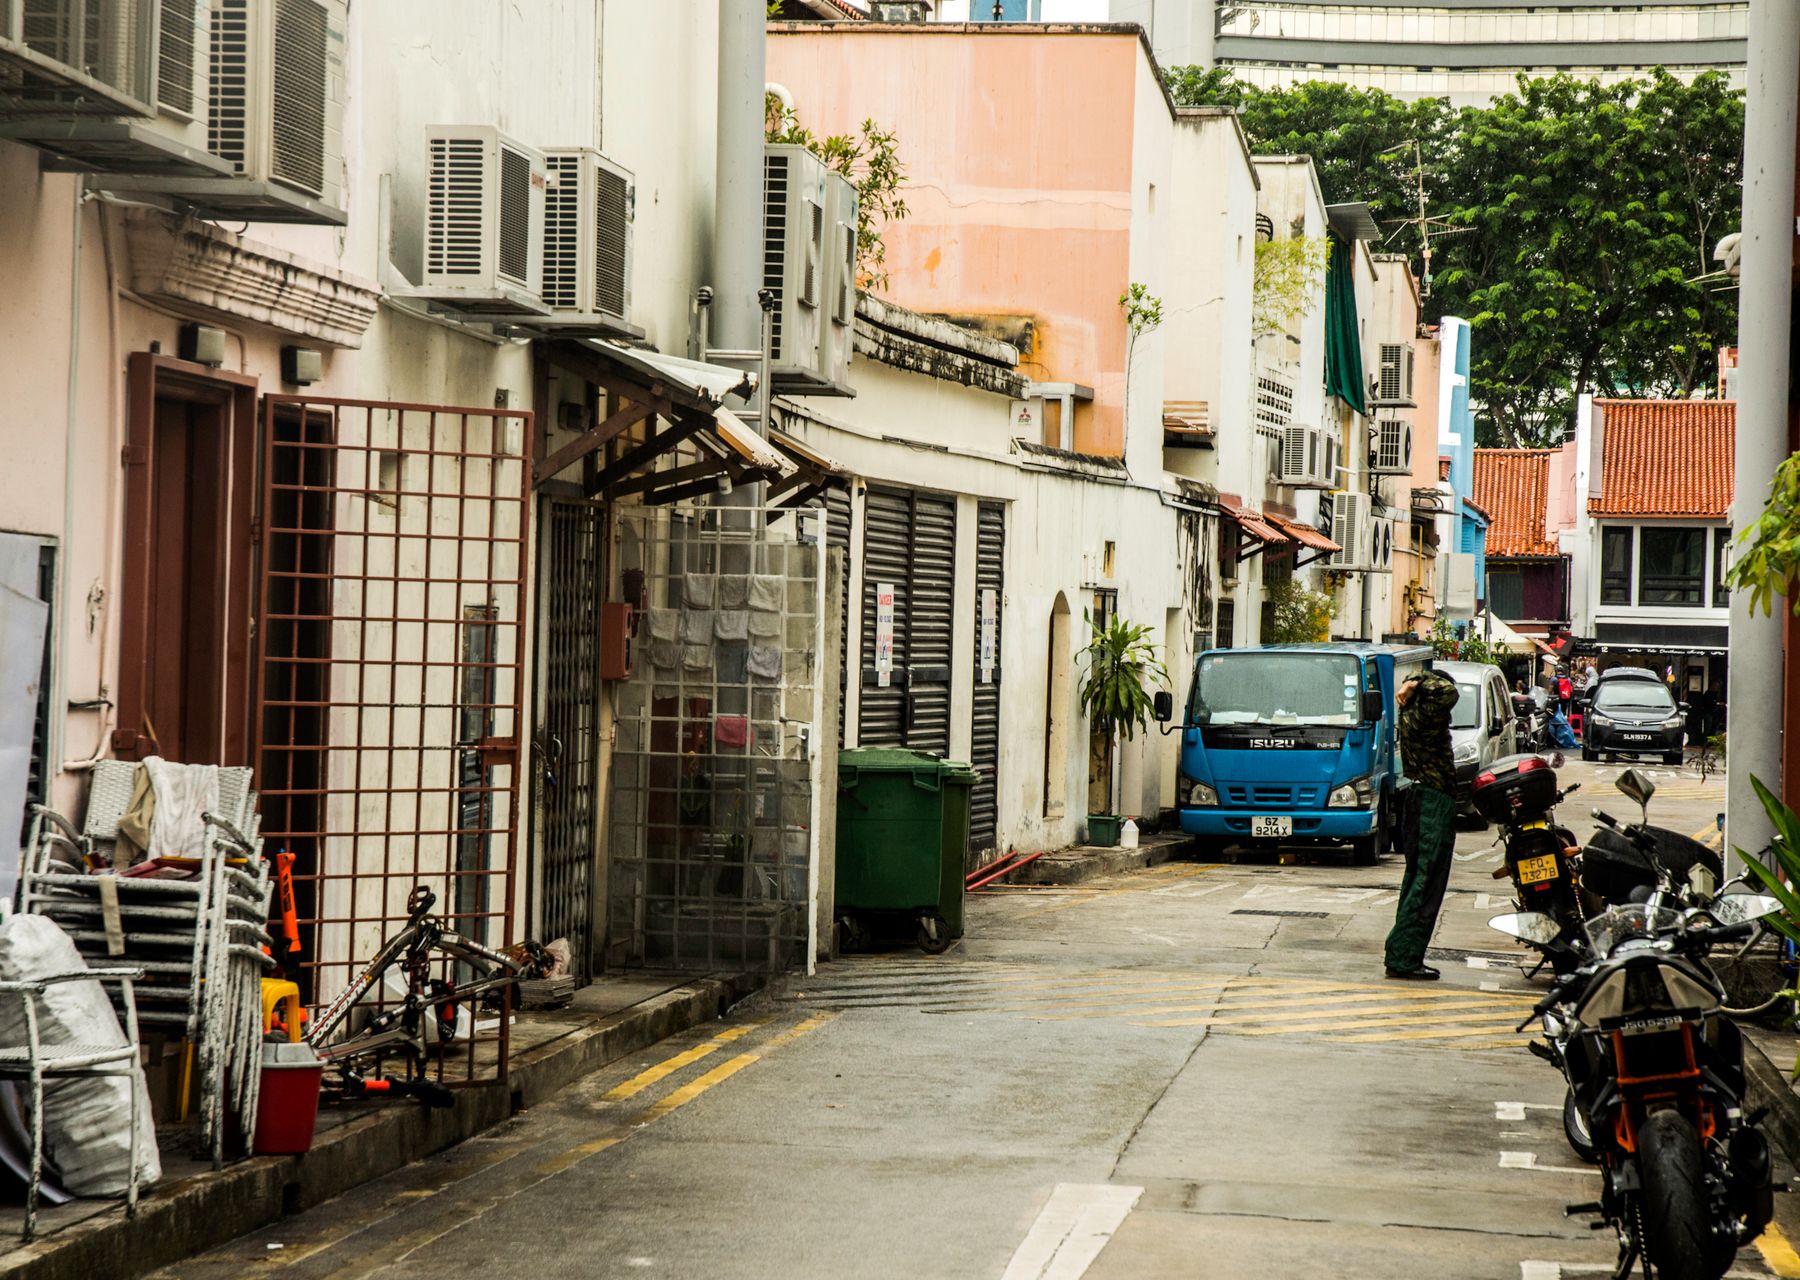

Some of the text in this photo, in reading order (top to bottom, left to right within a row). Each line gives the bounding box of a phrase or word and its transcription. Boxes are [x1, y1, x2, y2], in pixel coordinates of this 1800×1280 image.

[1250, 738, 1295, 749] ISUZU
[1265, 817, 1279, 826] GZ
[1529, 857, 1544, 869] FQ
